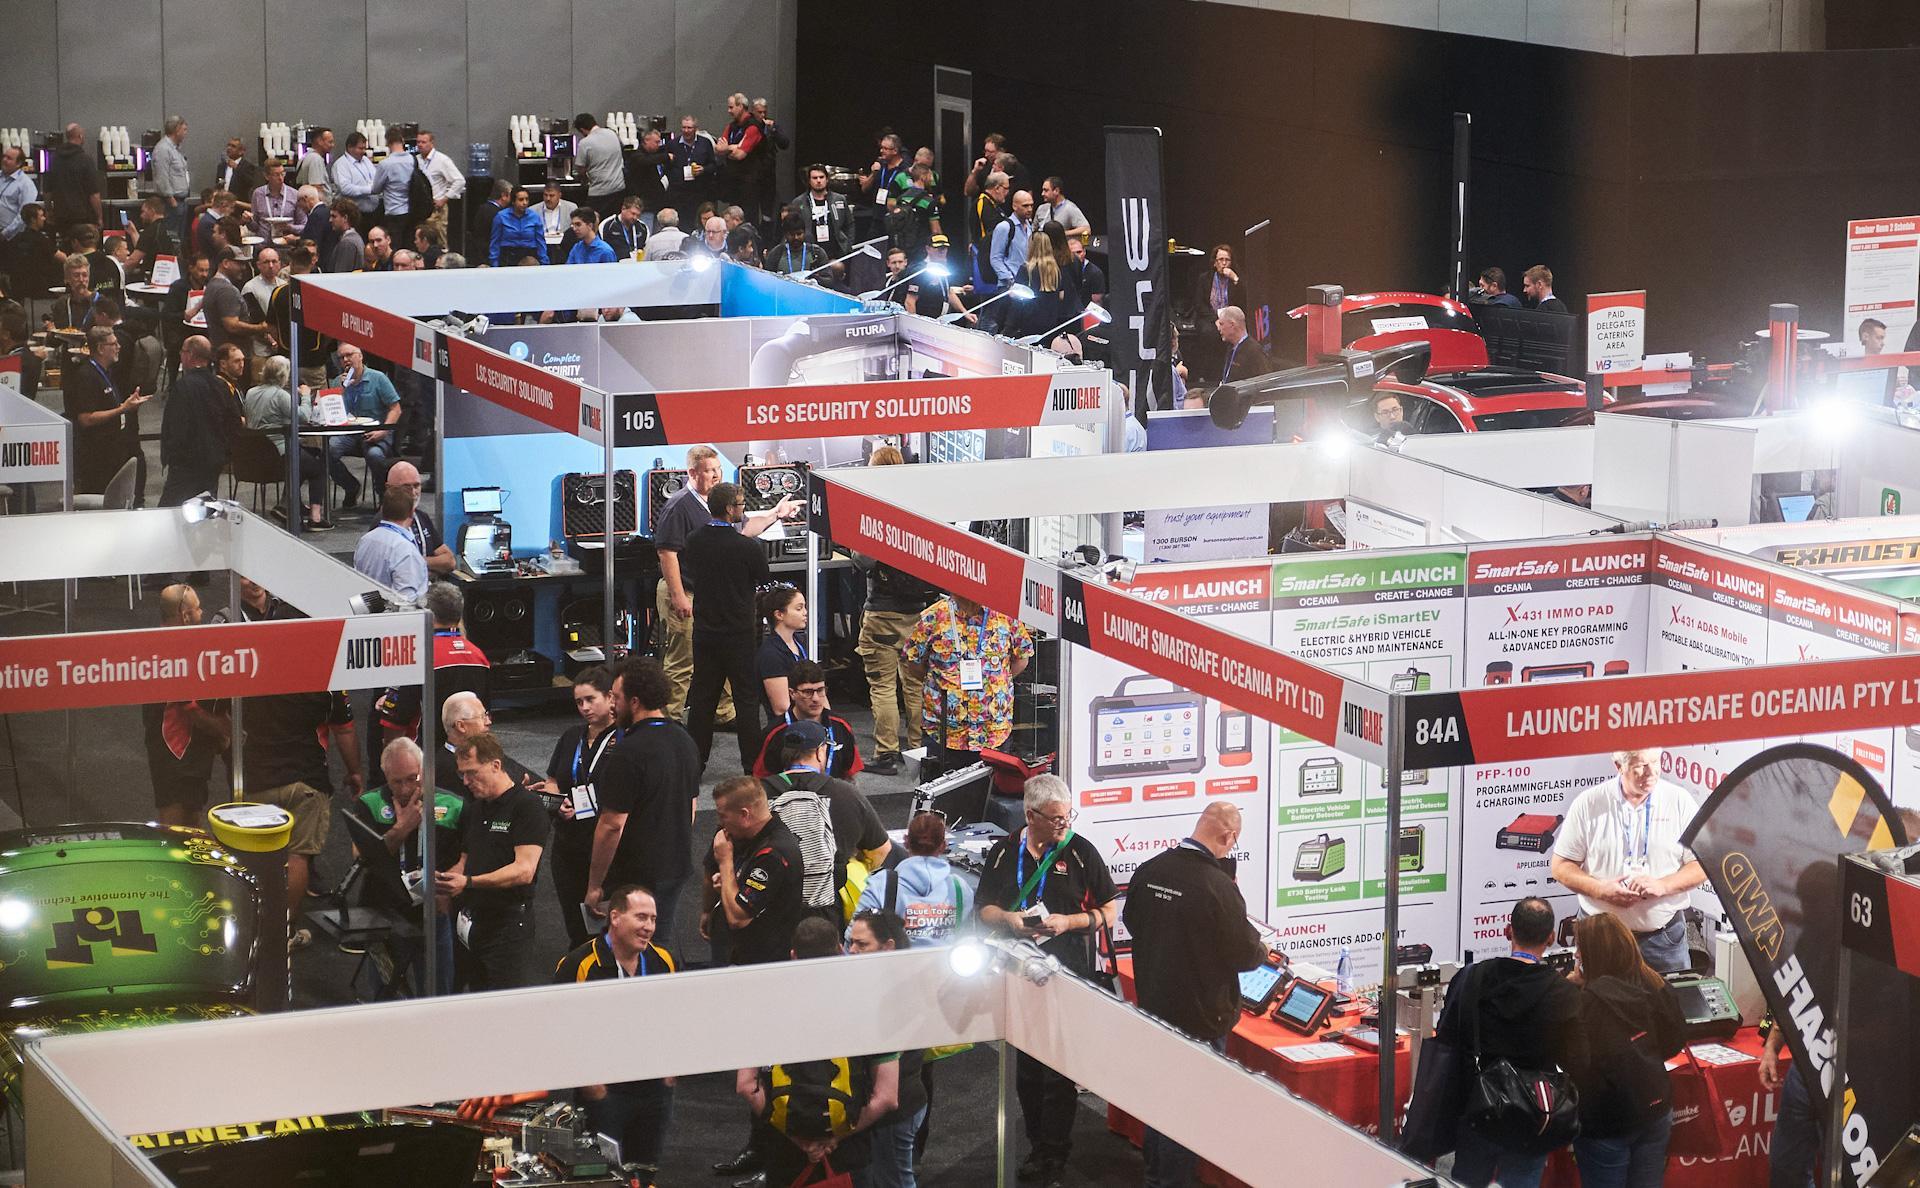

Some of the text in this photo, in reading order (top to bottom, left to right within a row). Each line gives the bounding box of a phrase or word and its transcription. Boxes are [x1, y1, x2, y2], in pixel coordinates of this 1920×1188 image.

[1596, 319, 1636, 330] DELEGATES
[1607, 310, 1625, 319] PAID
[349, 314, 374, 338] PHILLIPS
[845, 323, 887, 338] FUTURA
[1597, 330, 1635, 341] CATERING
[1606, 341, 1626, 350] AREA
[543, 352, 581, 364] Complete
[475, 362, 554, 411] LSC SECURITY SOLUTIONS
[1052, 387, 1101, 411] AUTOCARE
[746, 394, 972, 426] LSC SECURITY SOLUTIONS
[622, 410, 655, 431] 105
[2, 441, 60, 467] AUTOCARE
[811, 493, 822, 517] 84
[1164, 508, 1252, 527] trust your equipment
[860, 513, 987, 586] ADAS SOLUTIONS AUSTRALIA
[1152, 537, 1169, 545] 1300
[1169, 535, 1198, 544] BURSON
[1776, 542, 1920, 567] EXHAUST
[1474, 553, 1646, 579] SmartSafe LAUNCH
[1279, 566, 1457, 592] SmartSafe LAUNCH
[1493, 575, 1643, 594] OCEANIA CREATE CHANGE
[1657, 554, 1765, 599] SmartSafe LAUNCH
[1025, 577, 1054, 617] AUTOCARE
[1182, 579, 1262, 599] LAUNCH
[1299, 587, 1453, 607] OCEANIA CREATE CHANGE
[1667, 578, 1763, 615] OCEANIA CREATE CHANGE
[1065, 596, 1084, 626] 84A
[1177, 601, 1260, 615] CREATE CHANGE
[1547, 607, 1585, 619] IMMO
[1588, 604, 1615, 616] PAD
[1774, 588, 1832, 617] SmartSafe
[1839, 606, 1892, 637] LAUNCH
[1293, 609, 1441, 632] SmartSafe iSmartEV
[1300, 629, 1432, 647] ELECTRIC &HYBRID VEHICLE
[1488, 621, 1629, 641] ALL-IN-ONE KEY PROGRAMMING
[1696, 620, 1720, 636] ADAS
[1721, 628, 1748, 645] Mobile
[1786, 614, 1890, 652] OCEANIA CREATE CHANGE
[346, 634, 417, 670] AUTOCARE
[1355, 643, 1375, 655] AND
[1377, 640, 1444, 654] MAINTENANCE
[1502, 635, 1615, 653] &ADVANCED DIAGNOSTIC
[1689, 638, 1704, 652] ADAS
[1704, 643, 1741, 663] CALIBRATION
[56, 655, 188, 686] Technician
[196, 647, 260, 682] (TaT)
[1103, 611, 1325, 720] LAUNCH SMARTSAFE OCEANIA PTY LTD
[1506, 703, 1600, 739] LAUNCH
[1607, 694, 1744, 730] SMARTSAFE
[1750, 685, 1846, 718] OCEANIA
[1853, 680, 1896, 709] PTY
[1343, 701, 1384, 746] AUTOCARE
[1415, 715, 1460, 746] 84A
[1476, 766, 1531, 781] PFP-100
[1476, 780, 1572, 796] PROGRAMMINGFLASH
[1300, 805, 1326, 814] Electric
[1326, 803, 1351, 811] Vehicle
[1476, 792, 1565, 809] 4 CHARGING MODES
[1291, 810, 1345, 822] Battery Detector
[1516, 860, 1550, 870] APPLICABLE
[80, 890, 148, 902] Automotive
[150, 889, 170, 900] The
[1305, 887, 1329, 896] Battery
[1474, 913, 1512, 926] TWT-10
[1850, 892, 1874, 928] 63
[906, 916, 956, 927] TOWIN
[1276, 923, 1326, 938] LAUNCH
[45, 907, 158, 970] TaT
[1276, 942, 1288, 951] EV
[1290, 935, 1352, 951] DIAGNOSTICS
